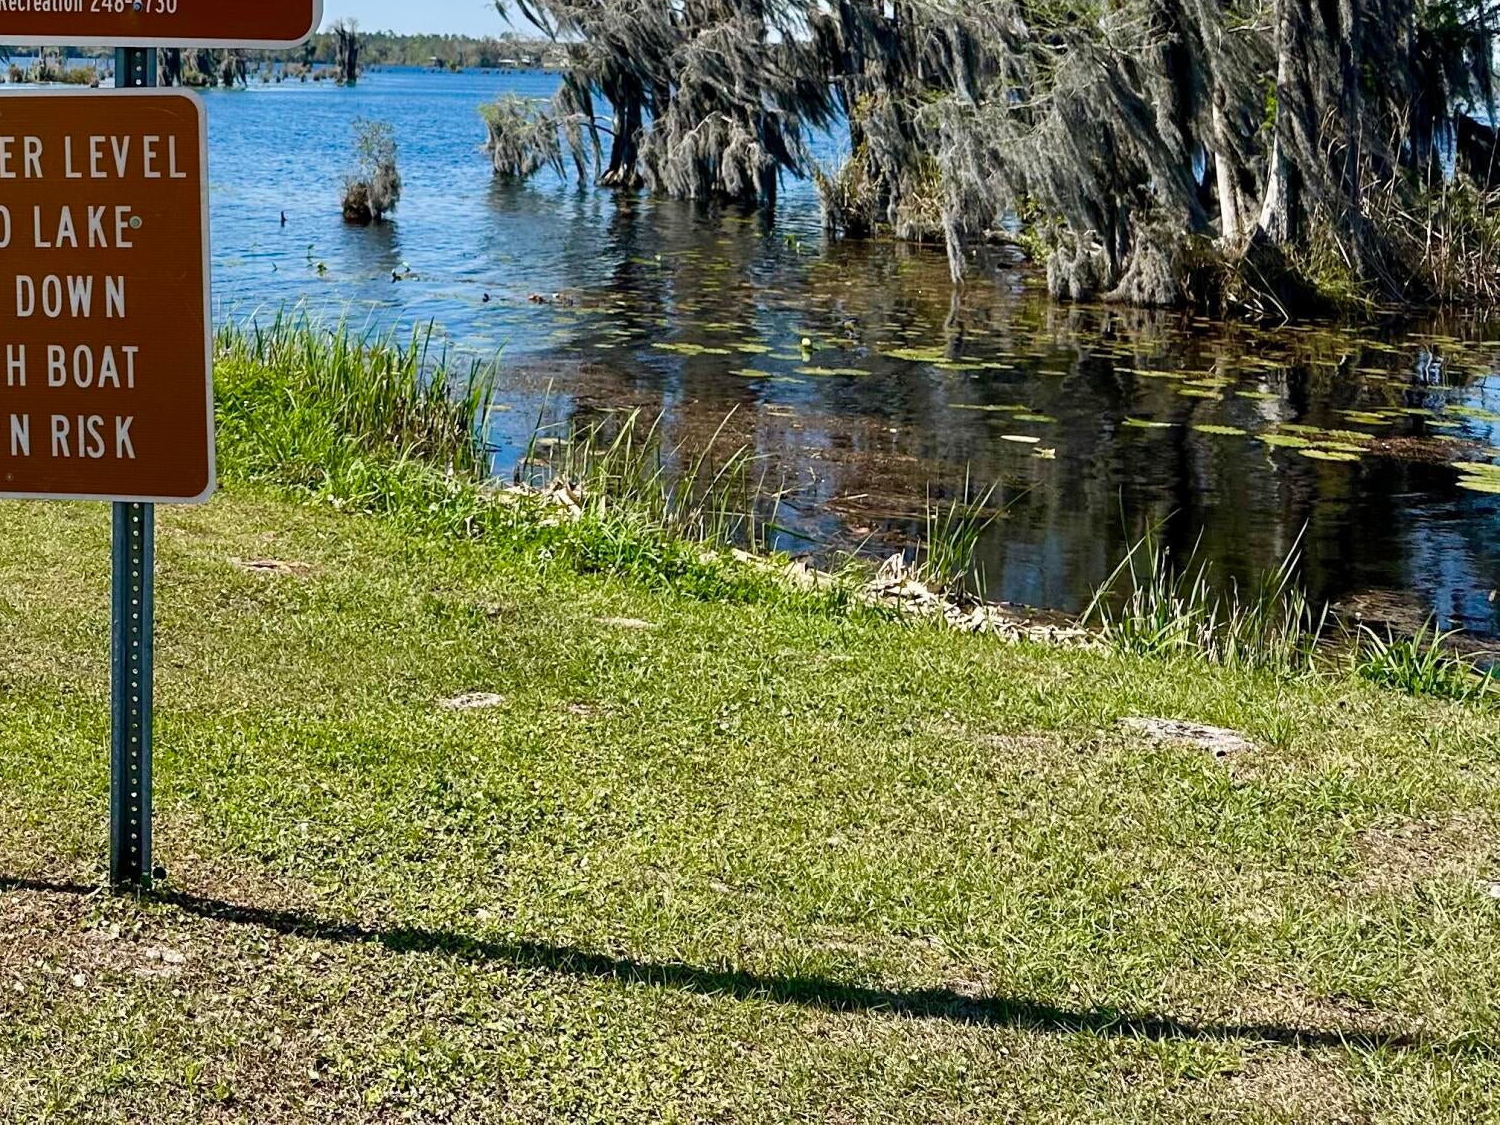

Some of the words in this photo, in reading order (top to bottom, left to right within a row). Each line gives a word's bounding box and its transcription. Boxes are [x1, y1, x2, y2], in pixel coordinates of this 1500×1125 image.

[65, 136, 186, 177] LEVEL
[33, 206, 134, 248] LAKE
[16, 275, 124, 317] DOWN
[48, 345, 138, 388] BOAT
[52, 415, 135, 458] RISK
